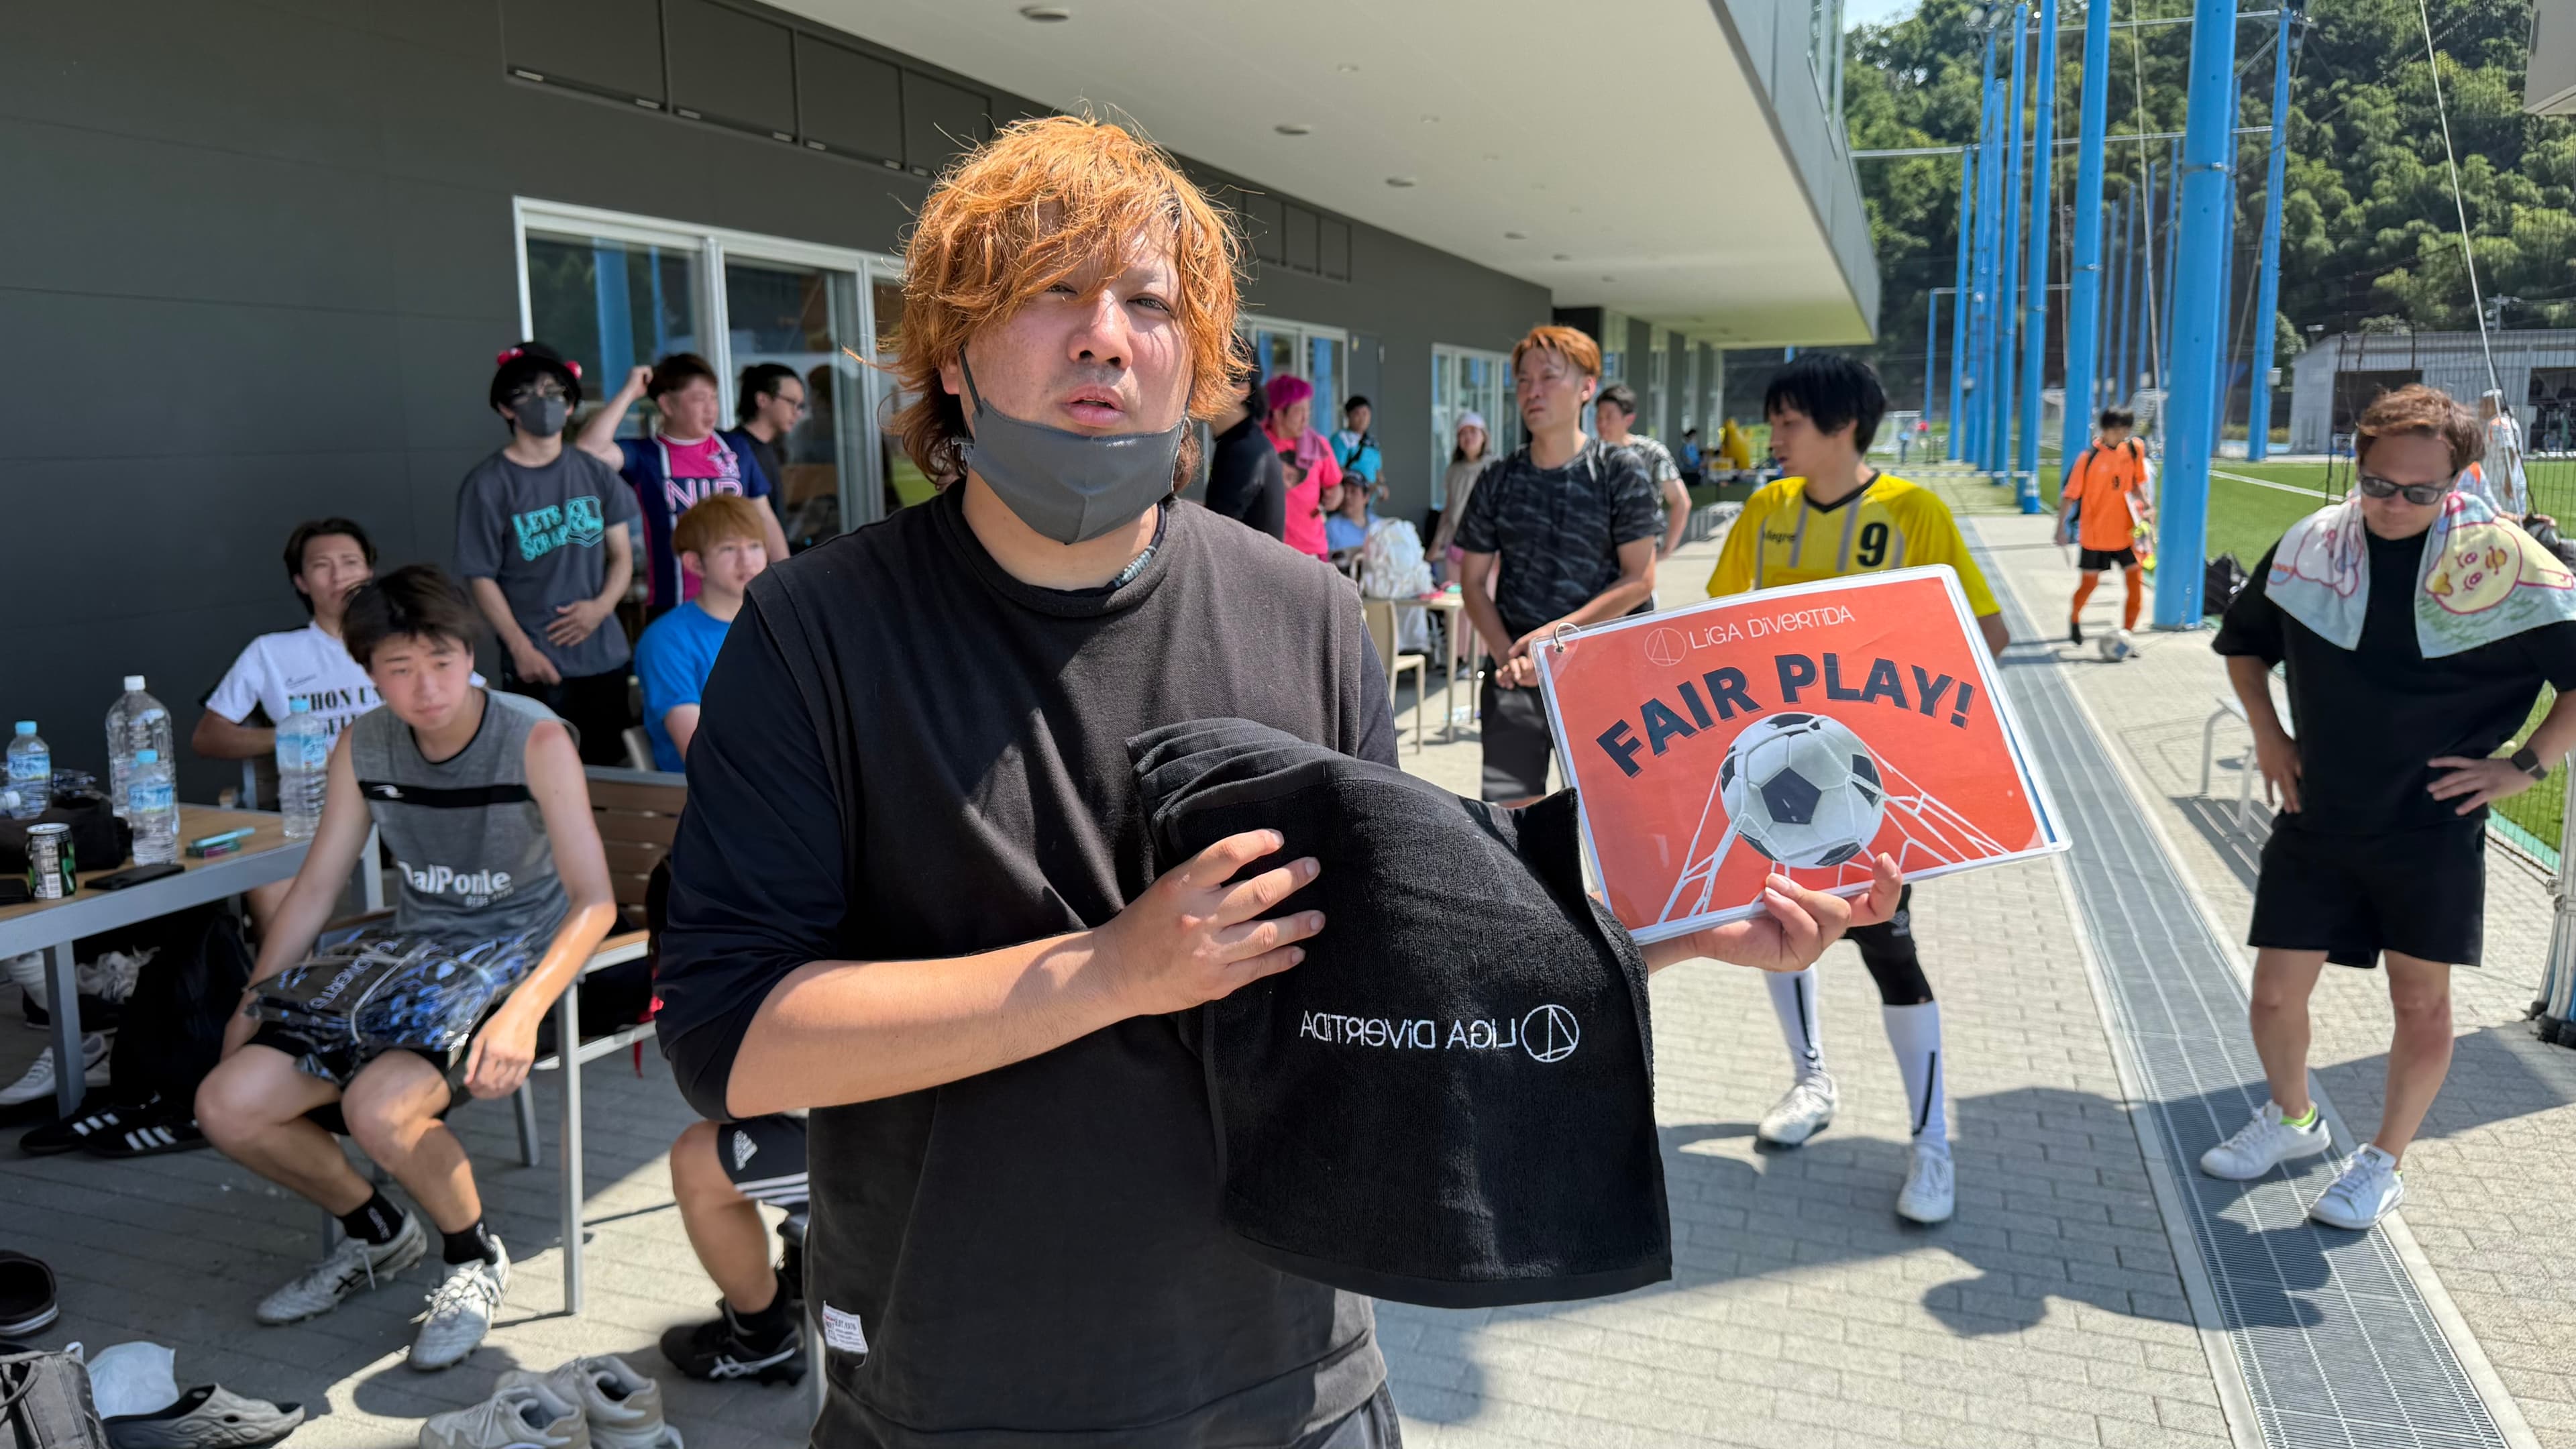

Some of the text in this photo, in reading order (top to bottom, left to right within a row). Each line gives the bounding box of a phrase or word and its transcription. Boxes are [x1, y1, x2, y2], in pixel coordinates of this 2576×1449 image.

[1856, 523, 1888, 567] 9
[1596, 652, 1976, 780] FAIR PLAY!
